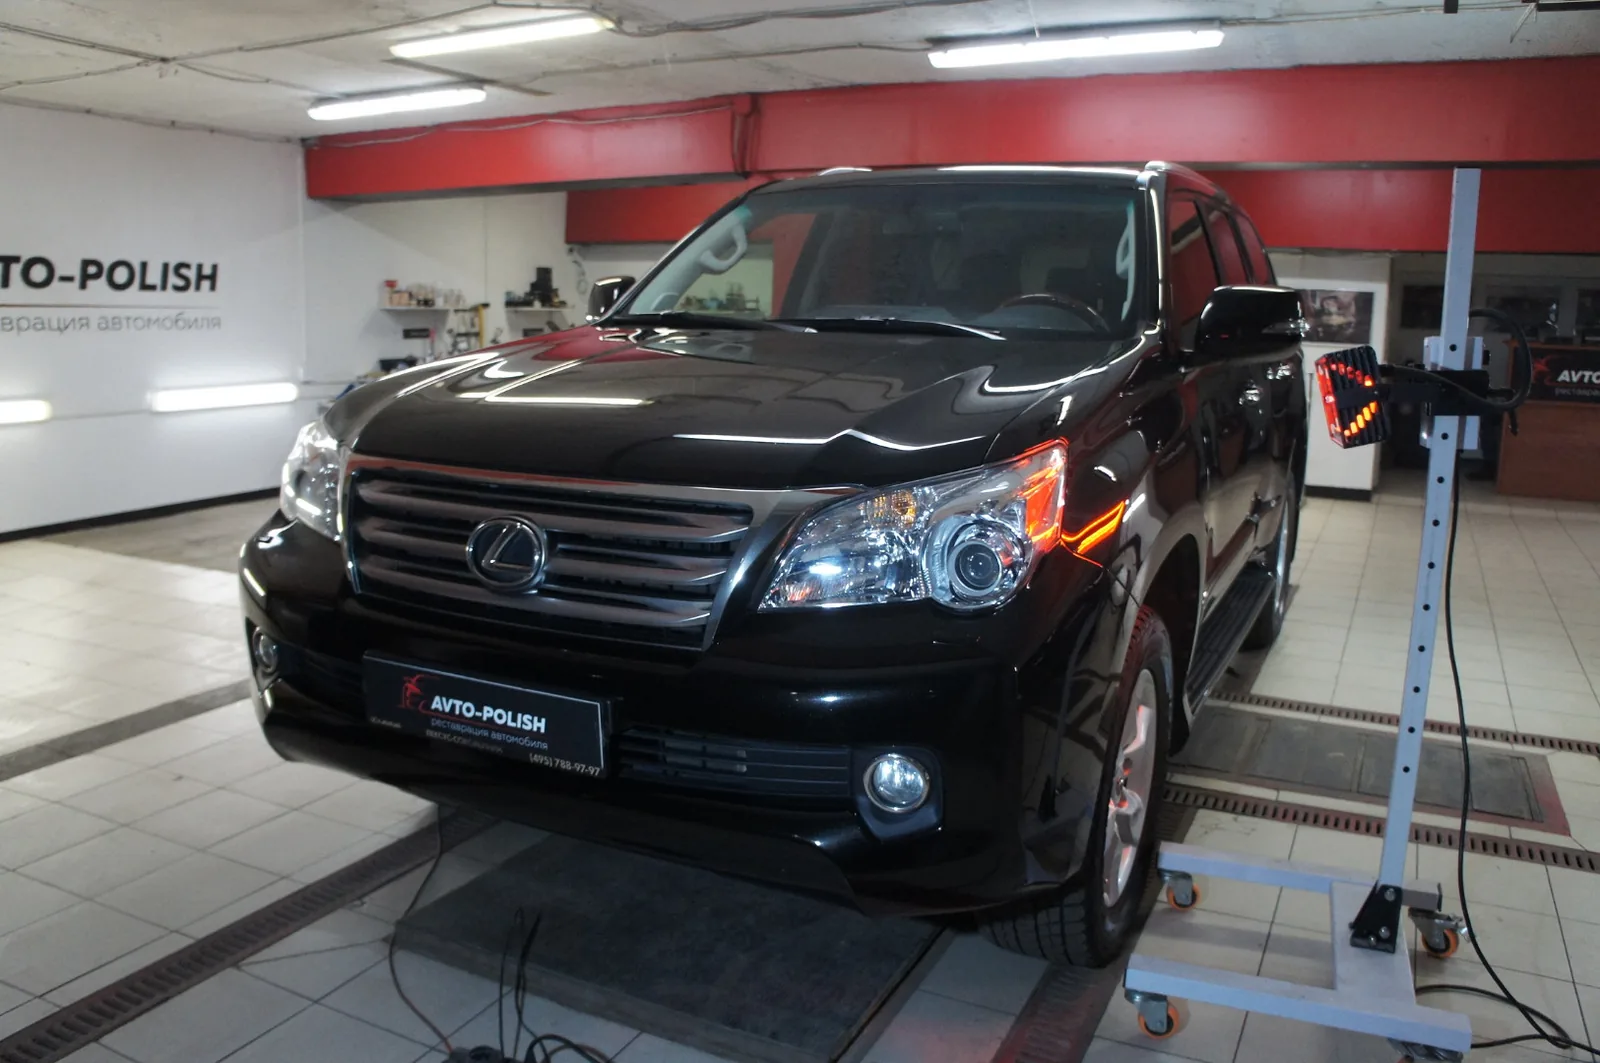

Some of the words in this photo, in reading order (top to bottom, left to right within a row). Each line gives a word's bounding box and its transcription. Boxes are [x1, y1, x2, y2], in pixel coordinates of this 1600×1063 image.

[0, 255, 218, 292] TO-POLISH
[97, 311, 222, 331] автомобиля
[431, 695, 547, 733] AVTO-POLISH
[431, 717, 489, 738] реставрация
[490, 730, 548, 750] автомобиля
[529, 752, 553, 768] (495)
[553, 758, 601, 777] 788-97-97
